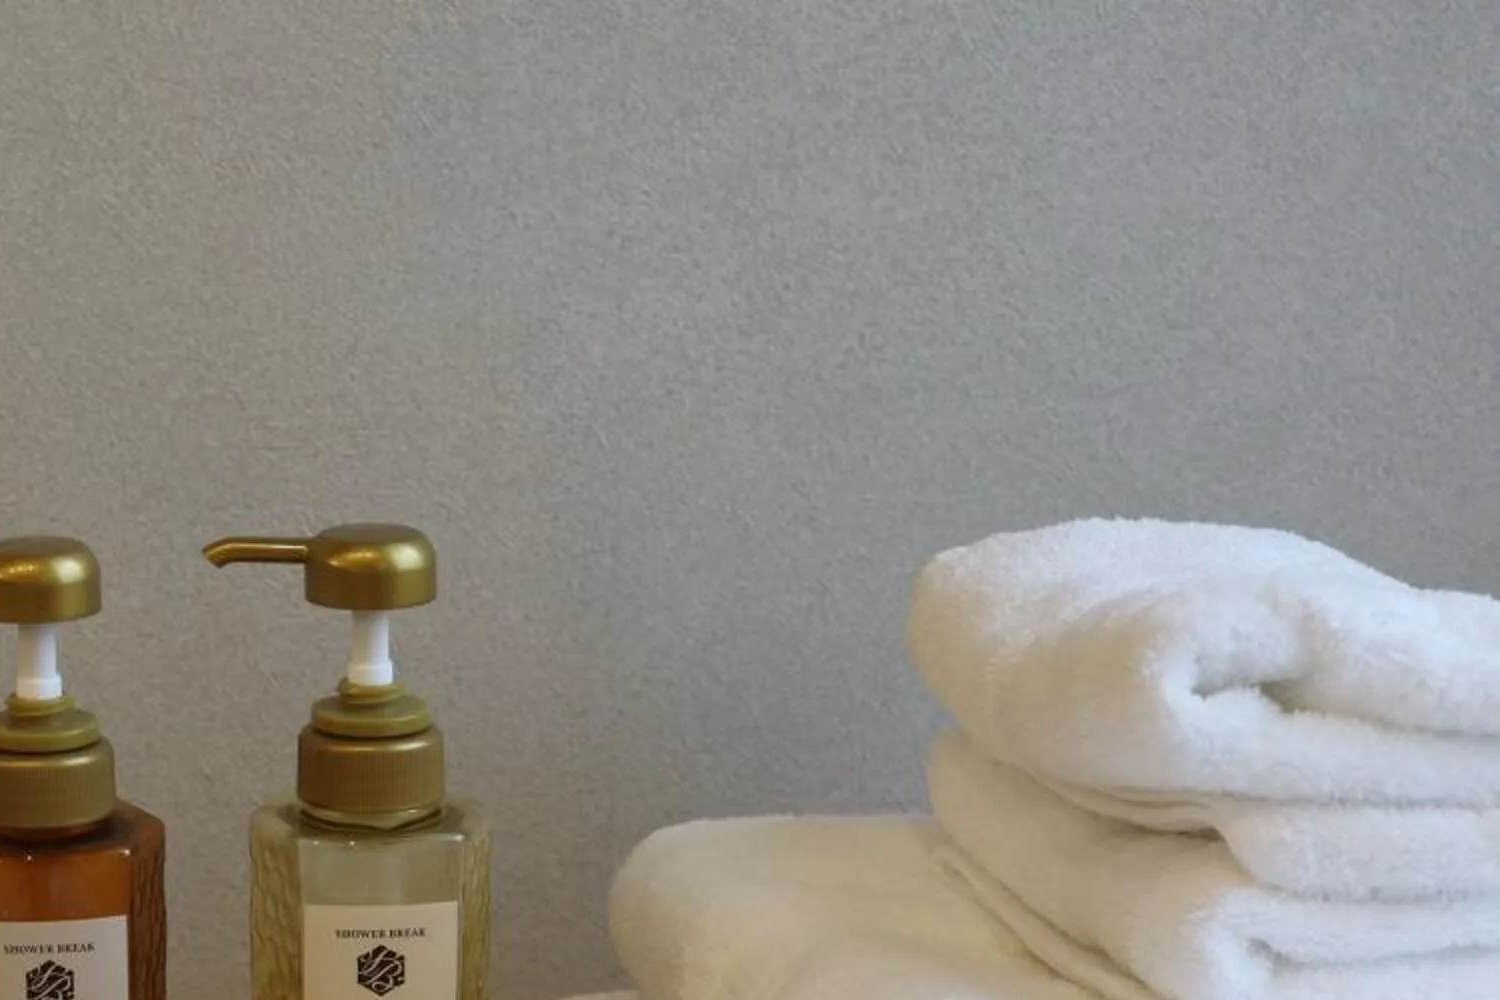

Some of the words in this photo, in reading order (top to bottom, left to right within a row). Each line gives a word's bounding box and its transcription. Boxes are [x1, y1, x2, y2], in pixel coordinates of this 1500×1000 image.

[335, 929, 386, 940] SHOWER
[389, 928, 426, 939] BREAK
[4, 944, 55, 955] SHOWER
[57, 942, 95, 953] BREAK
